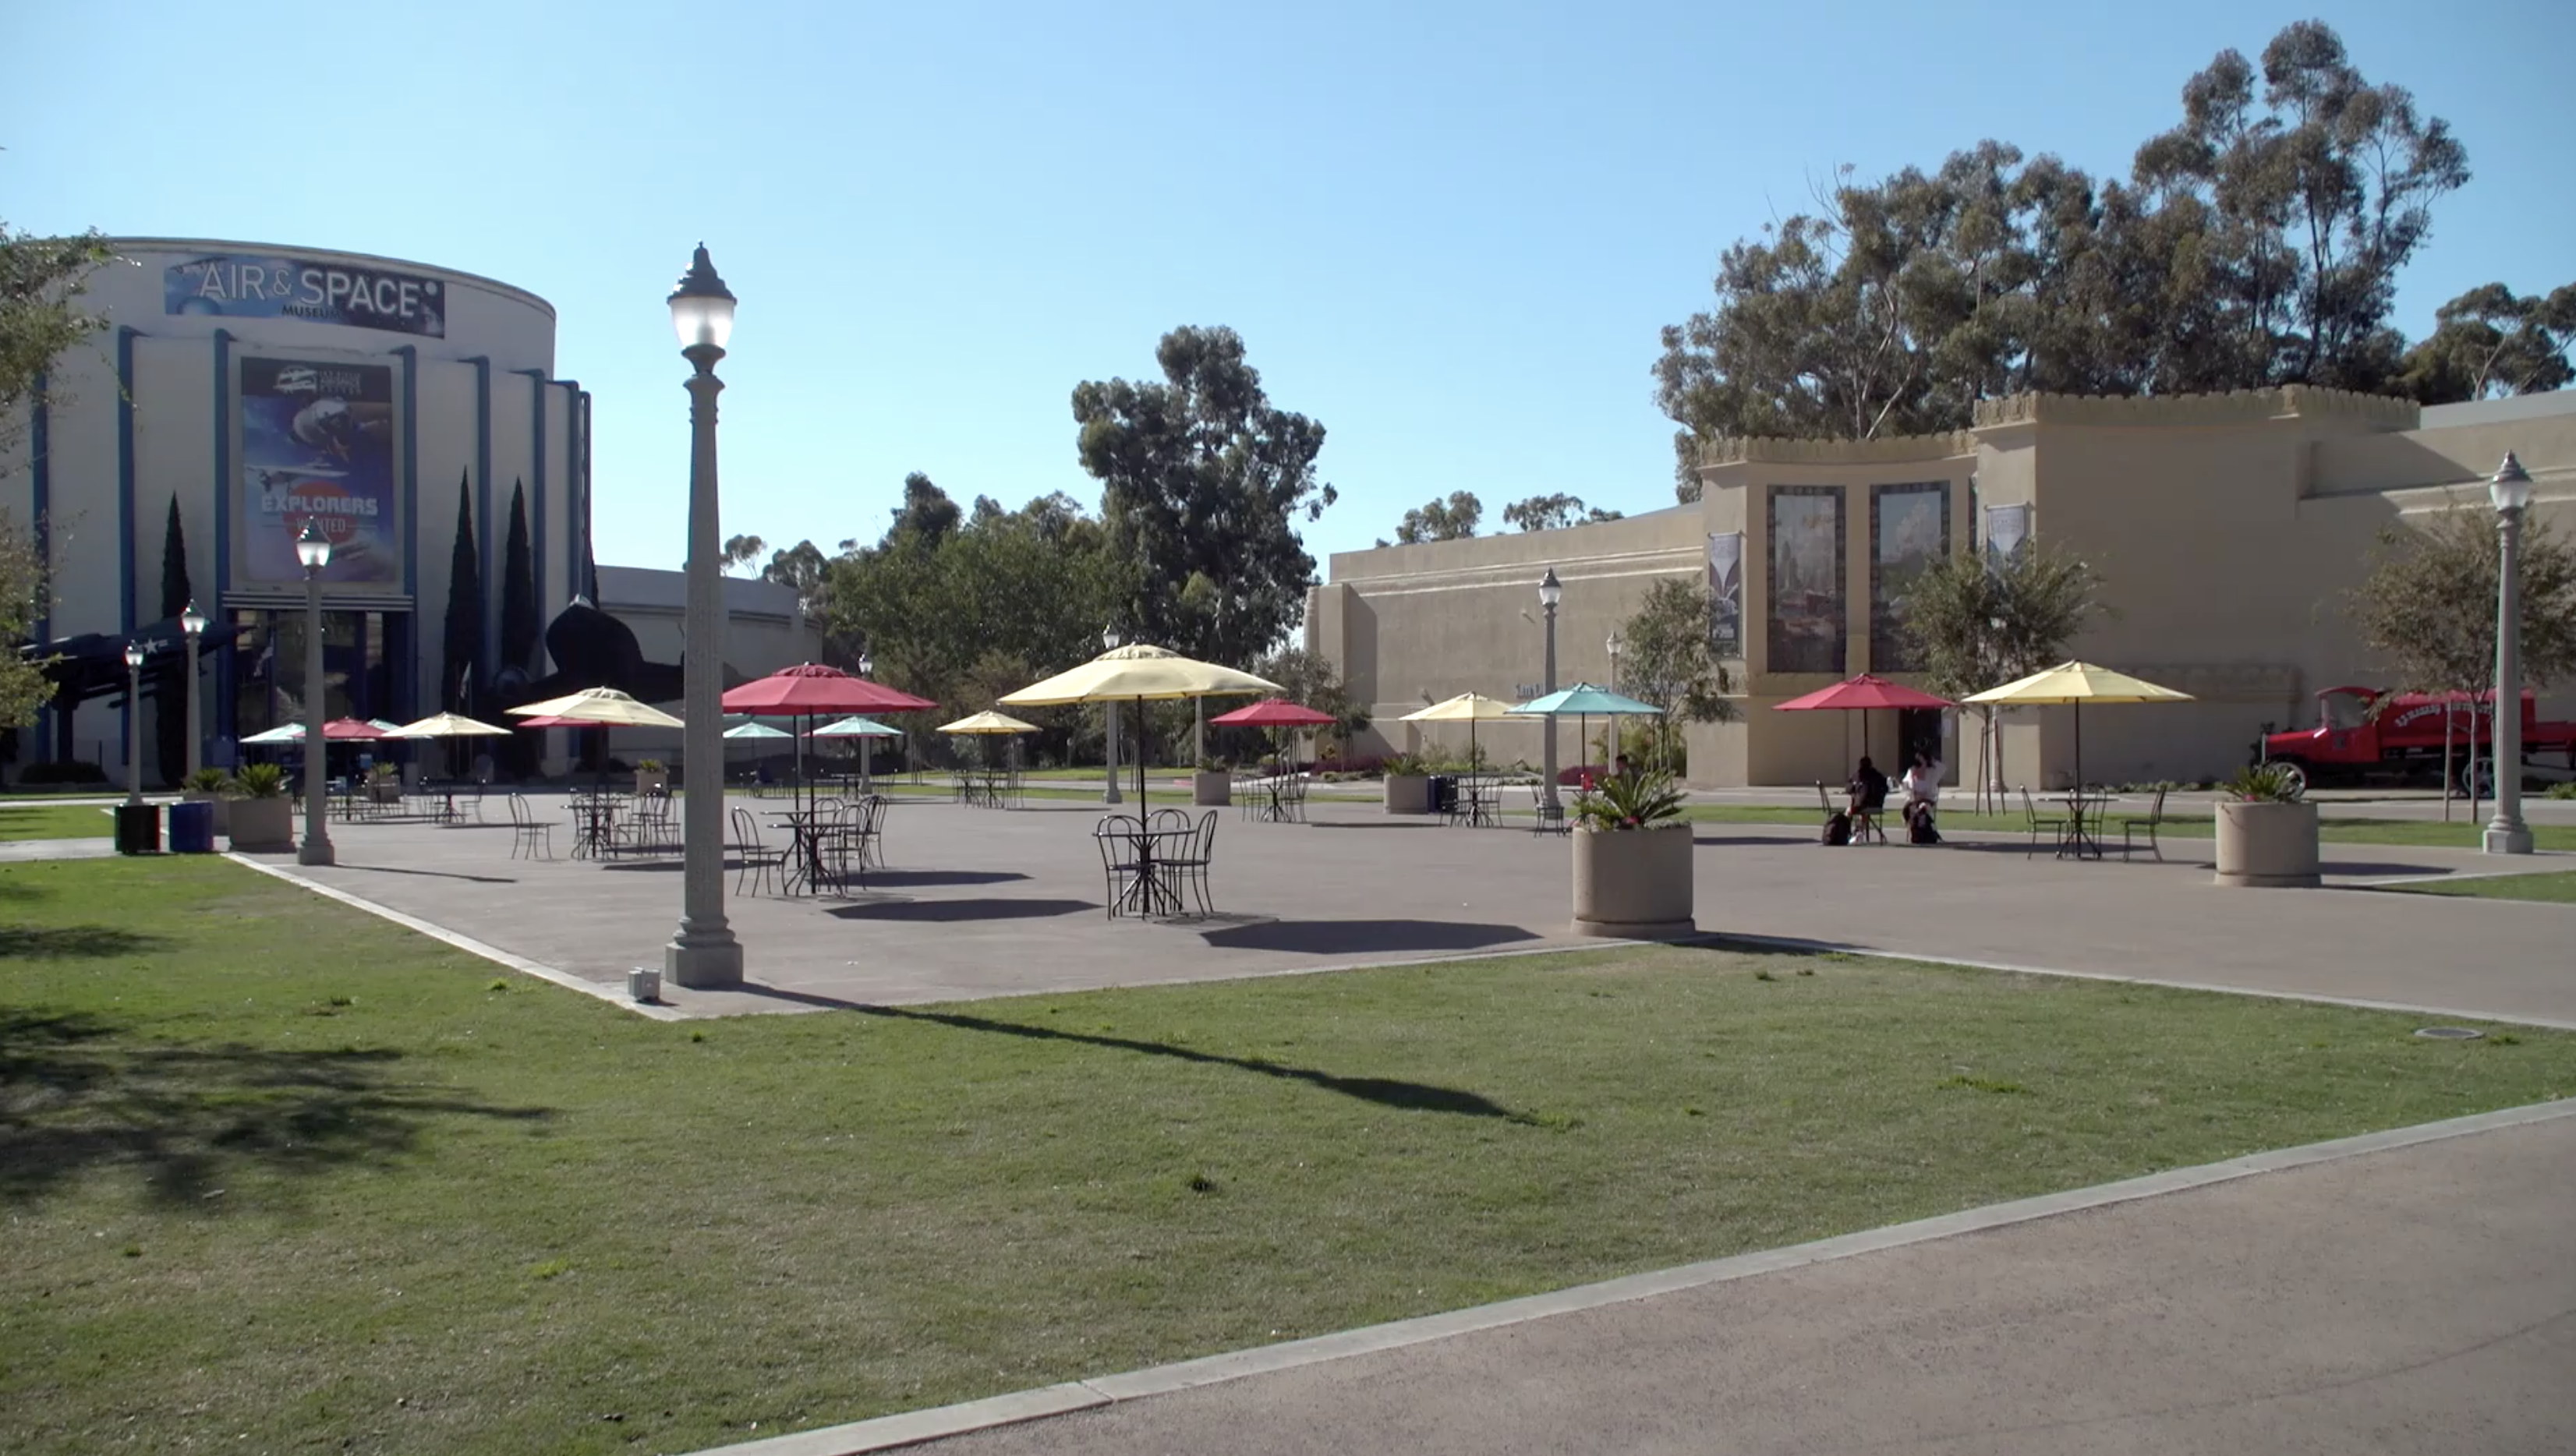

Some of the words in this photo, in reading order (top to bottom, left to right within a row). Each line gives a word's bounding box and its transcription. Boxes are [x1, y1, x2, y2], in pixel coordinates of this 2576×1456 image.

[200, 263, 265, 300] AIR
[273, 270, 292, 295] &
[301, 270, 420, 317] SPACE
[281, 304, 341, 319] MUSEUM
[261, 495, 379, 516] EXPLORERS
